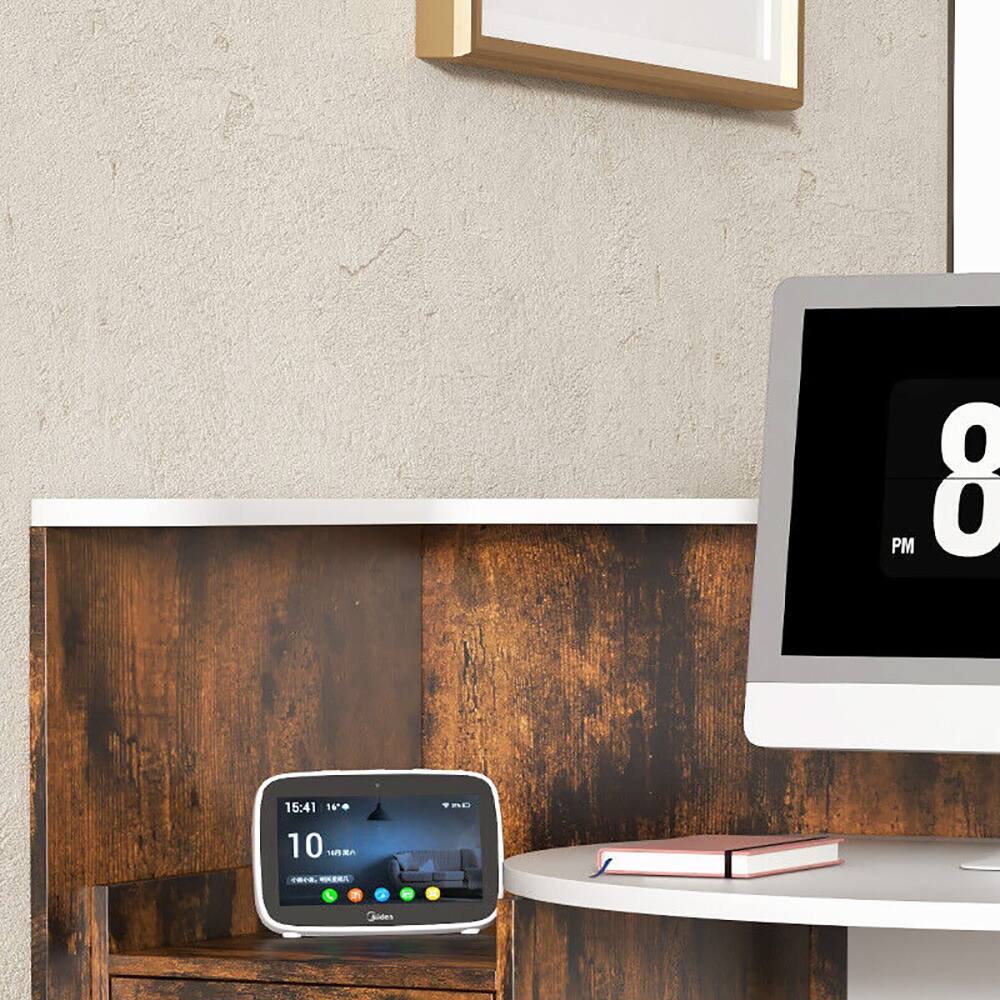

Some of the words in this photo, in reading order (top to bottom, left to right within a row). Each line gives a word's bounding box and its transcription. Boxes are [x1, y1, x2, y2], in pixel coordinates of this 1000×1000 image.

[891, 536, 915, 555] PM
[285, 801, 316, 813] 15:41
[288, 832, 323, 859] 10
